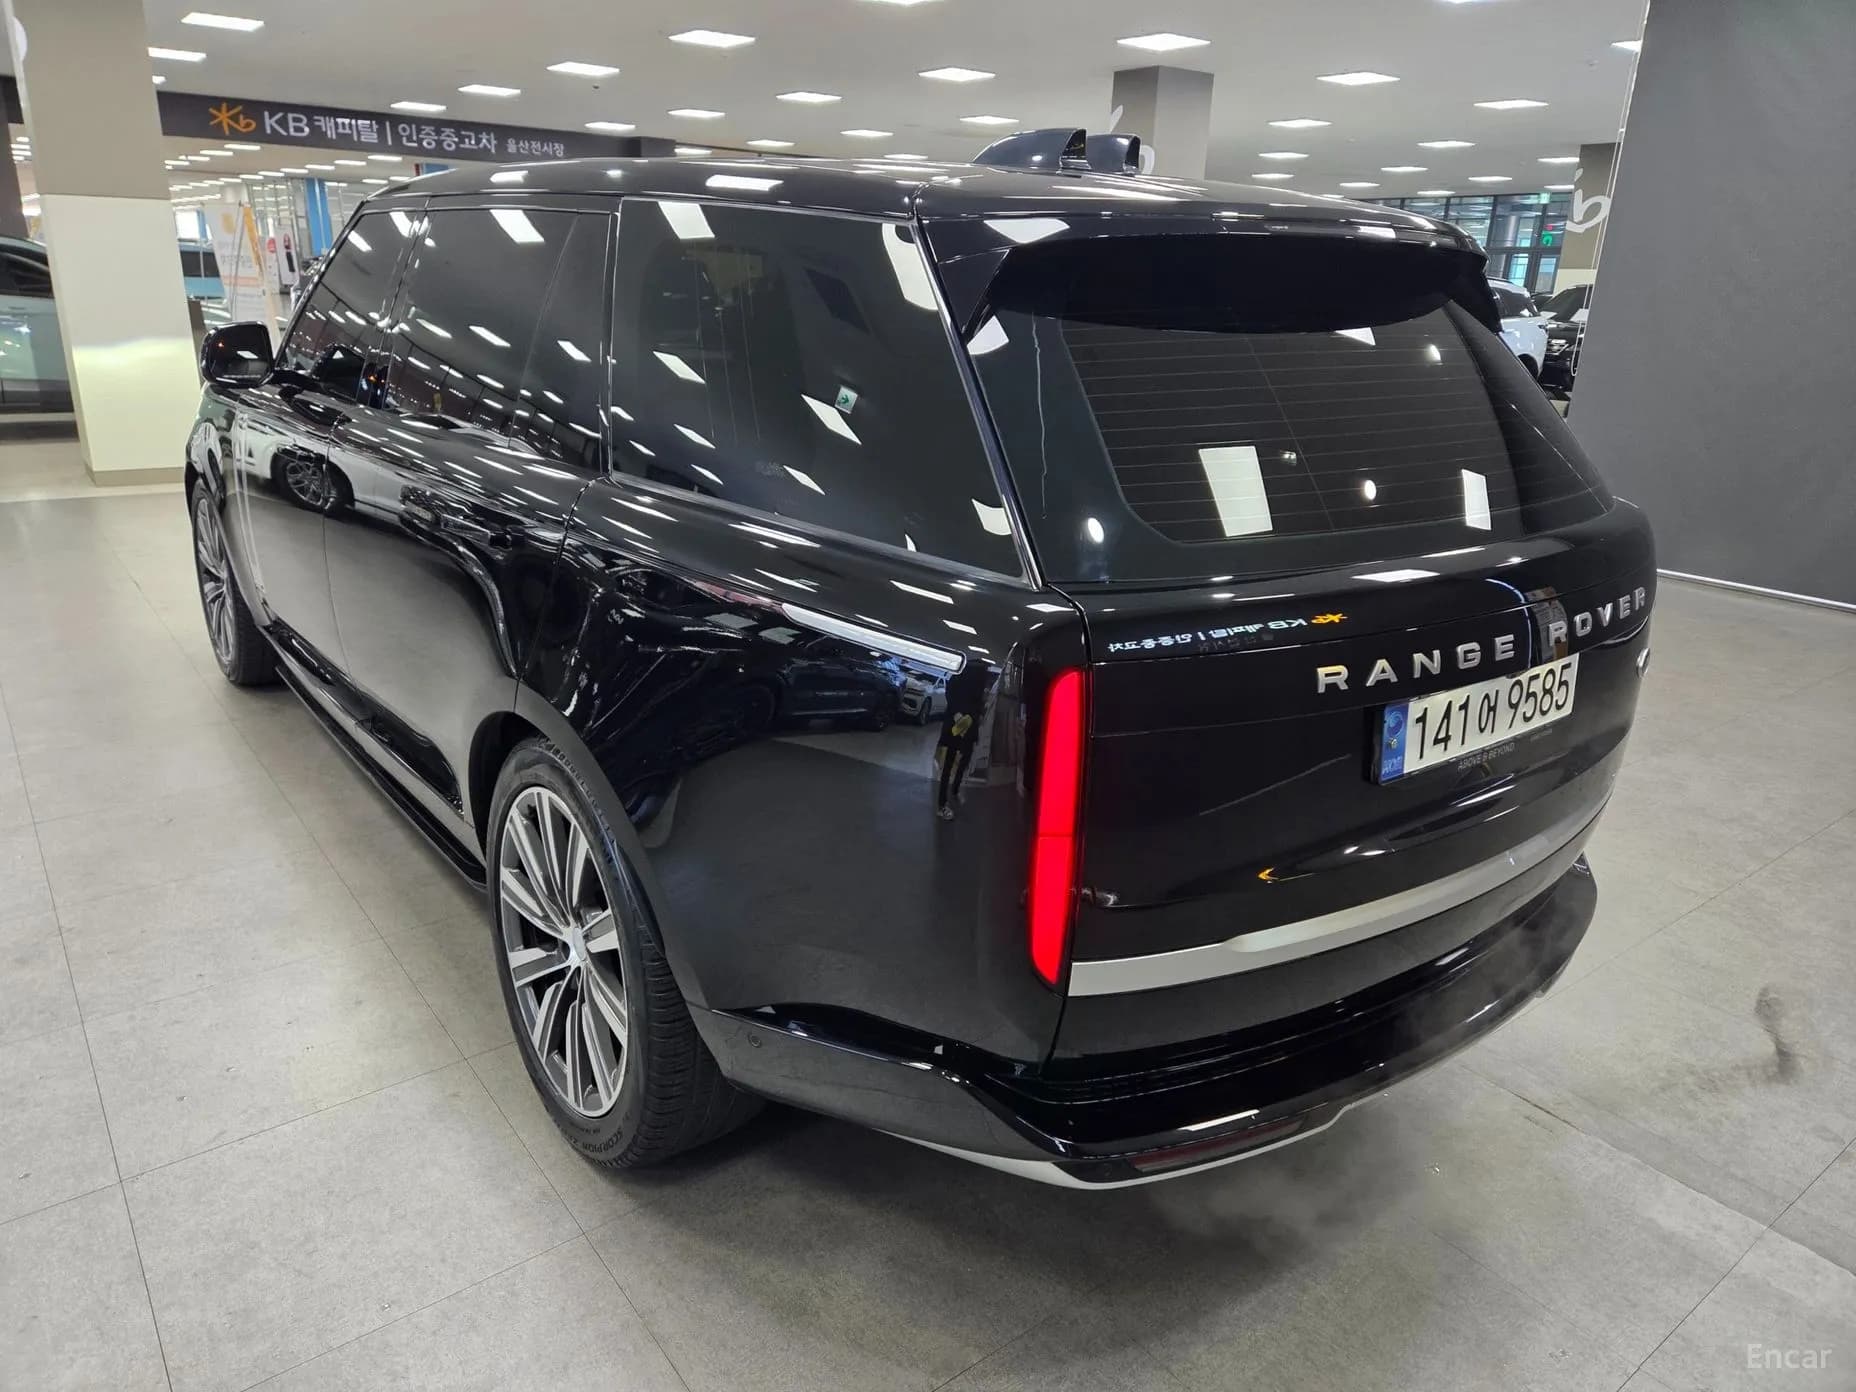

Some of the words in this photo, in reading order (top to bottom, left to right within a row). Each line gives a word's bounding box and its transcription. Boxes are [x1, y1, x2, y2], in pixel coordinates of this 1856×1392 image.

[264, 111, 310, 137] KB
[314, 115, 379, 144] 캐피탈
[397, 123, 498, 154] 인증중고차
[1316, 633, 1516, 694] RANGE
[1548, 586, 1647, 648] ROVER
